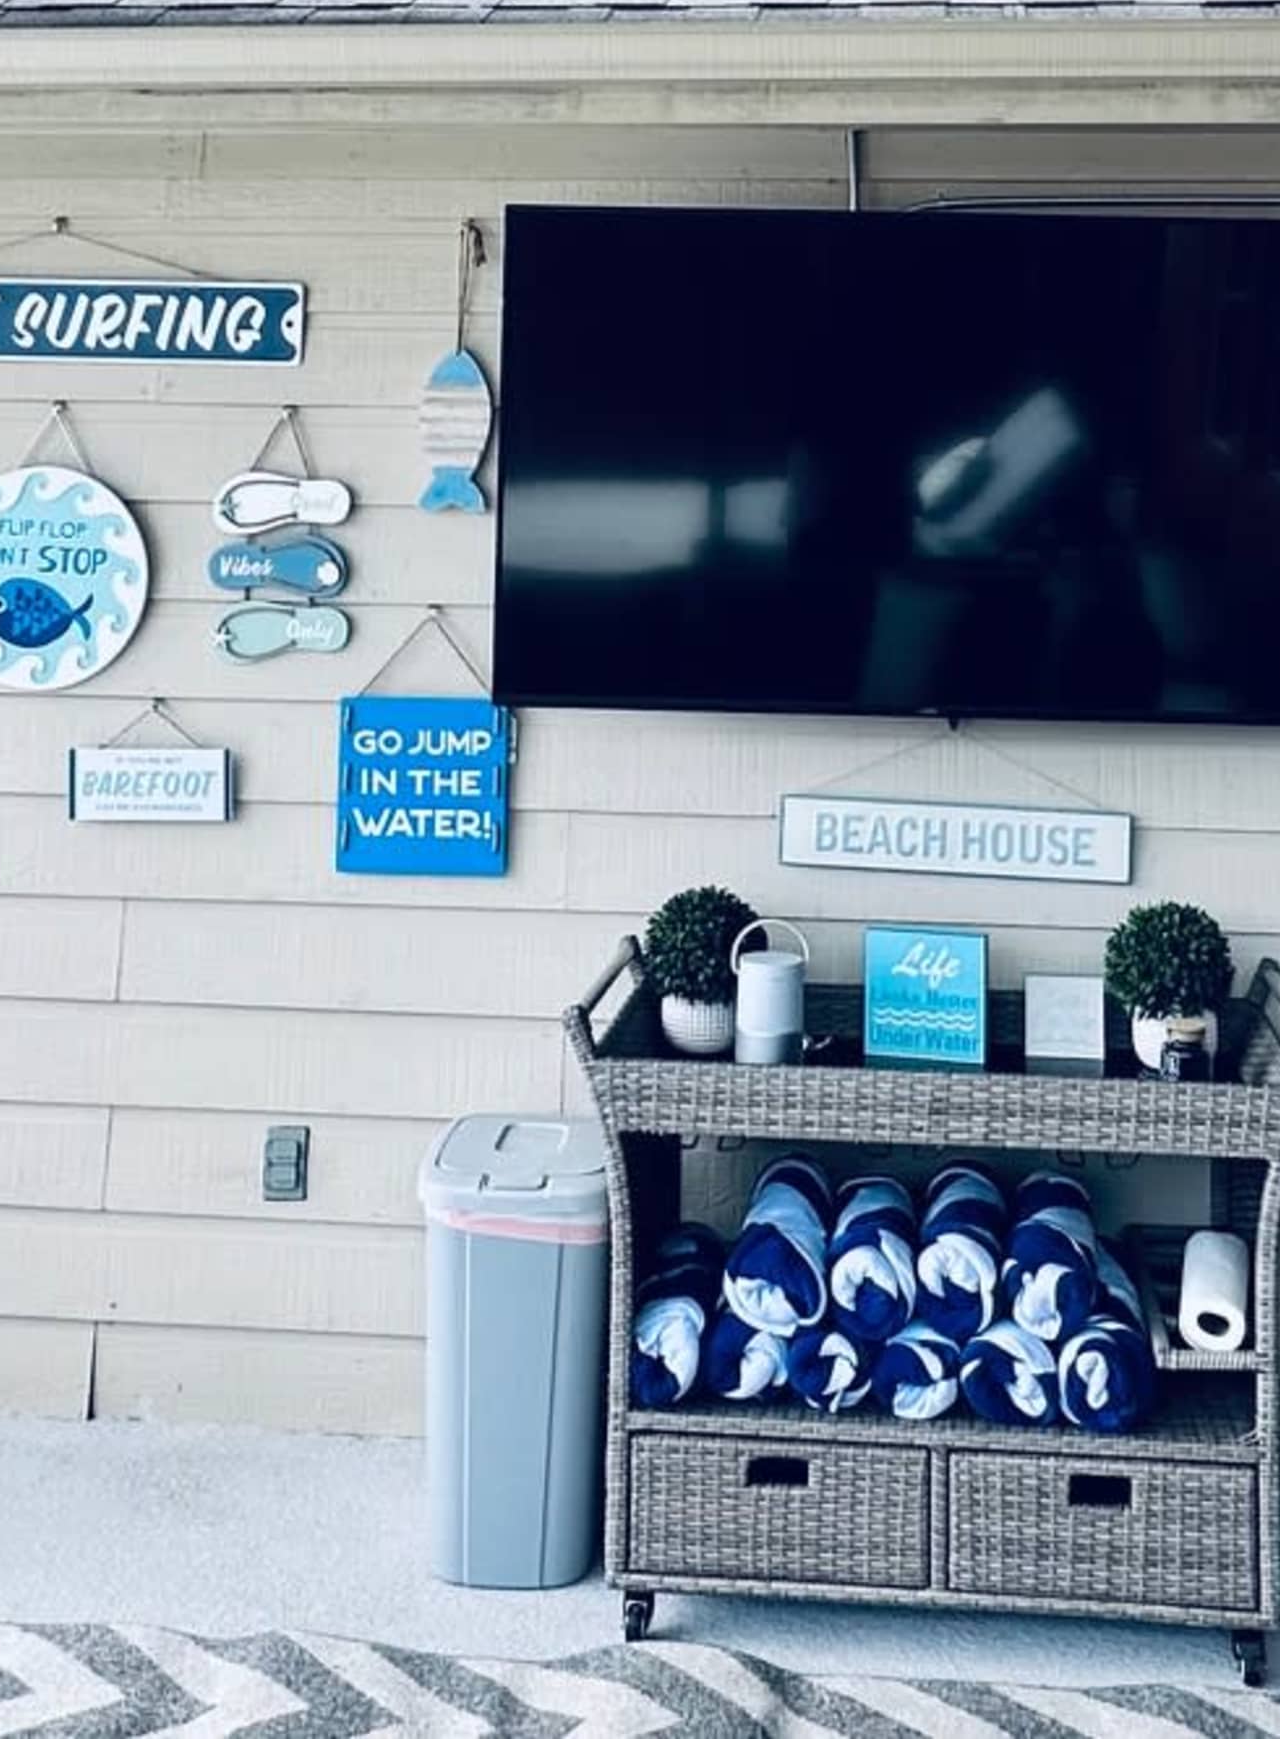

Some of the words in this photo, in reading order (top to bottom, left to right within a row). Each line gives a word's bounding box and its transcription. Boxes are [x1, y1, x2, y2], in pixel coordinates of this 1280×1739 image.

[11, 293, 266, 352] SURFING
[39, 521, 87, 539] FLOP
[38, 546, 107, 575] STOP
[353, 729, 403, 755] GO
[407, 730, 491, 756] JUMP
[82, 770, 216, 798] BAREFOOT
[361, 768, 397, 795] IN
[407, 769, 482, 796] THE
[353, 808, 491, 839] WATER!
[816, 812, 948, 859] BEACH
[962, 819, 1097, 866] HOUSE
[891, 942, 960, 989] Life
